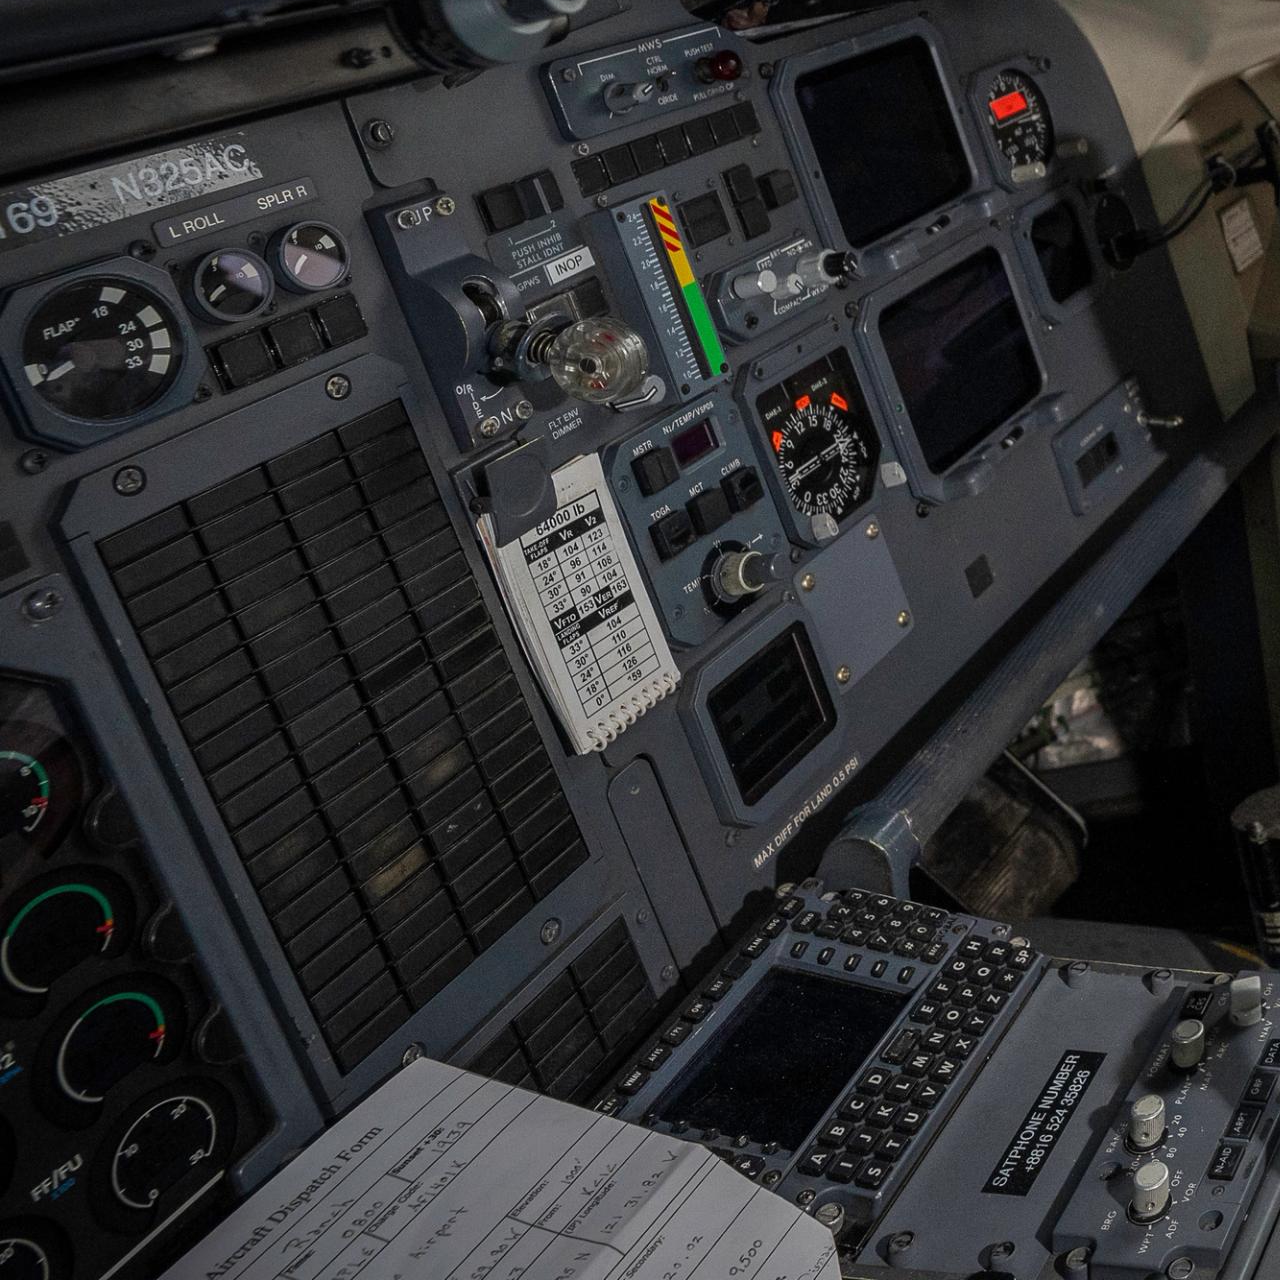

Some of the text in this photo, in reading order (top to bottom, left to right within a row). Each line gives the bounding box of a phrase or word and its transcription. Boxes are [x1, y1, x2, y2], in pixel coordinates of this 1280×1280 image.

[637, 38, 663, 54] MWS
[646, 55, 662, 66] CTRL
[647, 64, 668, 75] NORM
[110, 143, 250, 205] N325AC
[168, 184, 308, 239] L ROLL SPLR R
[511, 232, 562, 260] PUSH INHIB
[516, 241, 565, 269] STALL IDNT
[554, 254, 583, 276] INOP
[91, 305, 109, 319] 18
[118, 320, 137, 335] 24
[126, 337, 144, 351] 30
[125, 355, 144, 369] 33
[548, 408, 579, 431] FLT ENV
[551, 417, 583, 440] DIMMER
[631, 440, 654, 457] MSTR
[720, 458, 741, 476] CLIMB
[688, 481, 704, 497] MCT
[535, 504, 586, 536] 64000 lb
[650, 504, 672, 521] TOGA
[523, 516, 597, 556] TAKE-OFF VR V2
[563, 542, 579, 556] 104
[587, 528, 603, 543] 123
[530, 547, 549, 560] FLAPS
[569, 557, 582, 569] 96
[592, 542, 607, 557] 114
[575, 571, 587, 583] 91
[597, 556, 613, 570] 108
[580, 584, 592, 597] 90
[602, 570, 618, 584] 104
[554, 580, 627, 630] VFTO 153 VER 163
[555, 603, 620, 640] LANDING VREF
[606, 617, 622, 631] 104
[562, 631, 580, 645] FLAPS
[611, 630, 627, 645] 110
[616, 643, 632, 658] 116
[622, 657, 638, 671] 126
[753, 756, 859, 868] MAX DIFF FOR LAND 0.5 PSI
[1015, 949, 1030, 964] SP
[986, 994, 1001, 1004] Z
[913, 1055, 928, 1068] M
[1264, 1041, 1280, 1064] DATA
[938, 1061, 955, 1074] W
[869, 1074, 883, 1085] D
[922, 1087, 936, 1098] V
[171, 1103, 188, 1120] 20
[851, 1100, 864, 1110] C
[877, 1105, 893, 1116] K
[992, 1053, 1081, 1188] SATPHONE NUMBER
[1024, 1069, 1091, 1173] +8816 524 35826
[830, 1126, 845, 1136] B
[1105, 1121, 1129, 1153] RANGE
[189, 1148, 206, 1166] 30
[391, 1148, 424, 1176] Sunset
[811, 1153, 827, 1165] A
[1214, 1146, 1232, 1173] N-AID
[30, 1153, 84, 1203] FF/FU
[868, 1167, 881, 1176] S
[1171, 1169, 1184, 1187] OFF
[205, 1224, 273, 1280] Aircraft
[268, 1162, 341, 1225] Dispatch
[335, 1125, 385, 1163] Form
[510, 1179, 550, 1218] Elevation:
[580, 1180, 618, 1219] Longitude:
[1182, 1182, 1197, 1204] VOR
[366, 1181, 424, 1233] Charge Code:
[1101, 1209, 1117, 1232] BRG
[1165, 1218, 1179, 1239] ADF
[1137, 1233, 1152, 1255] WPT
